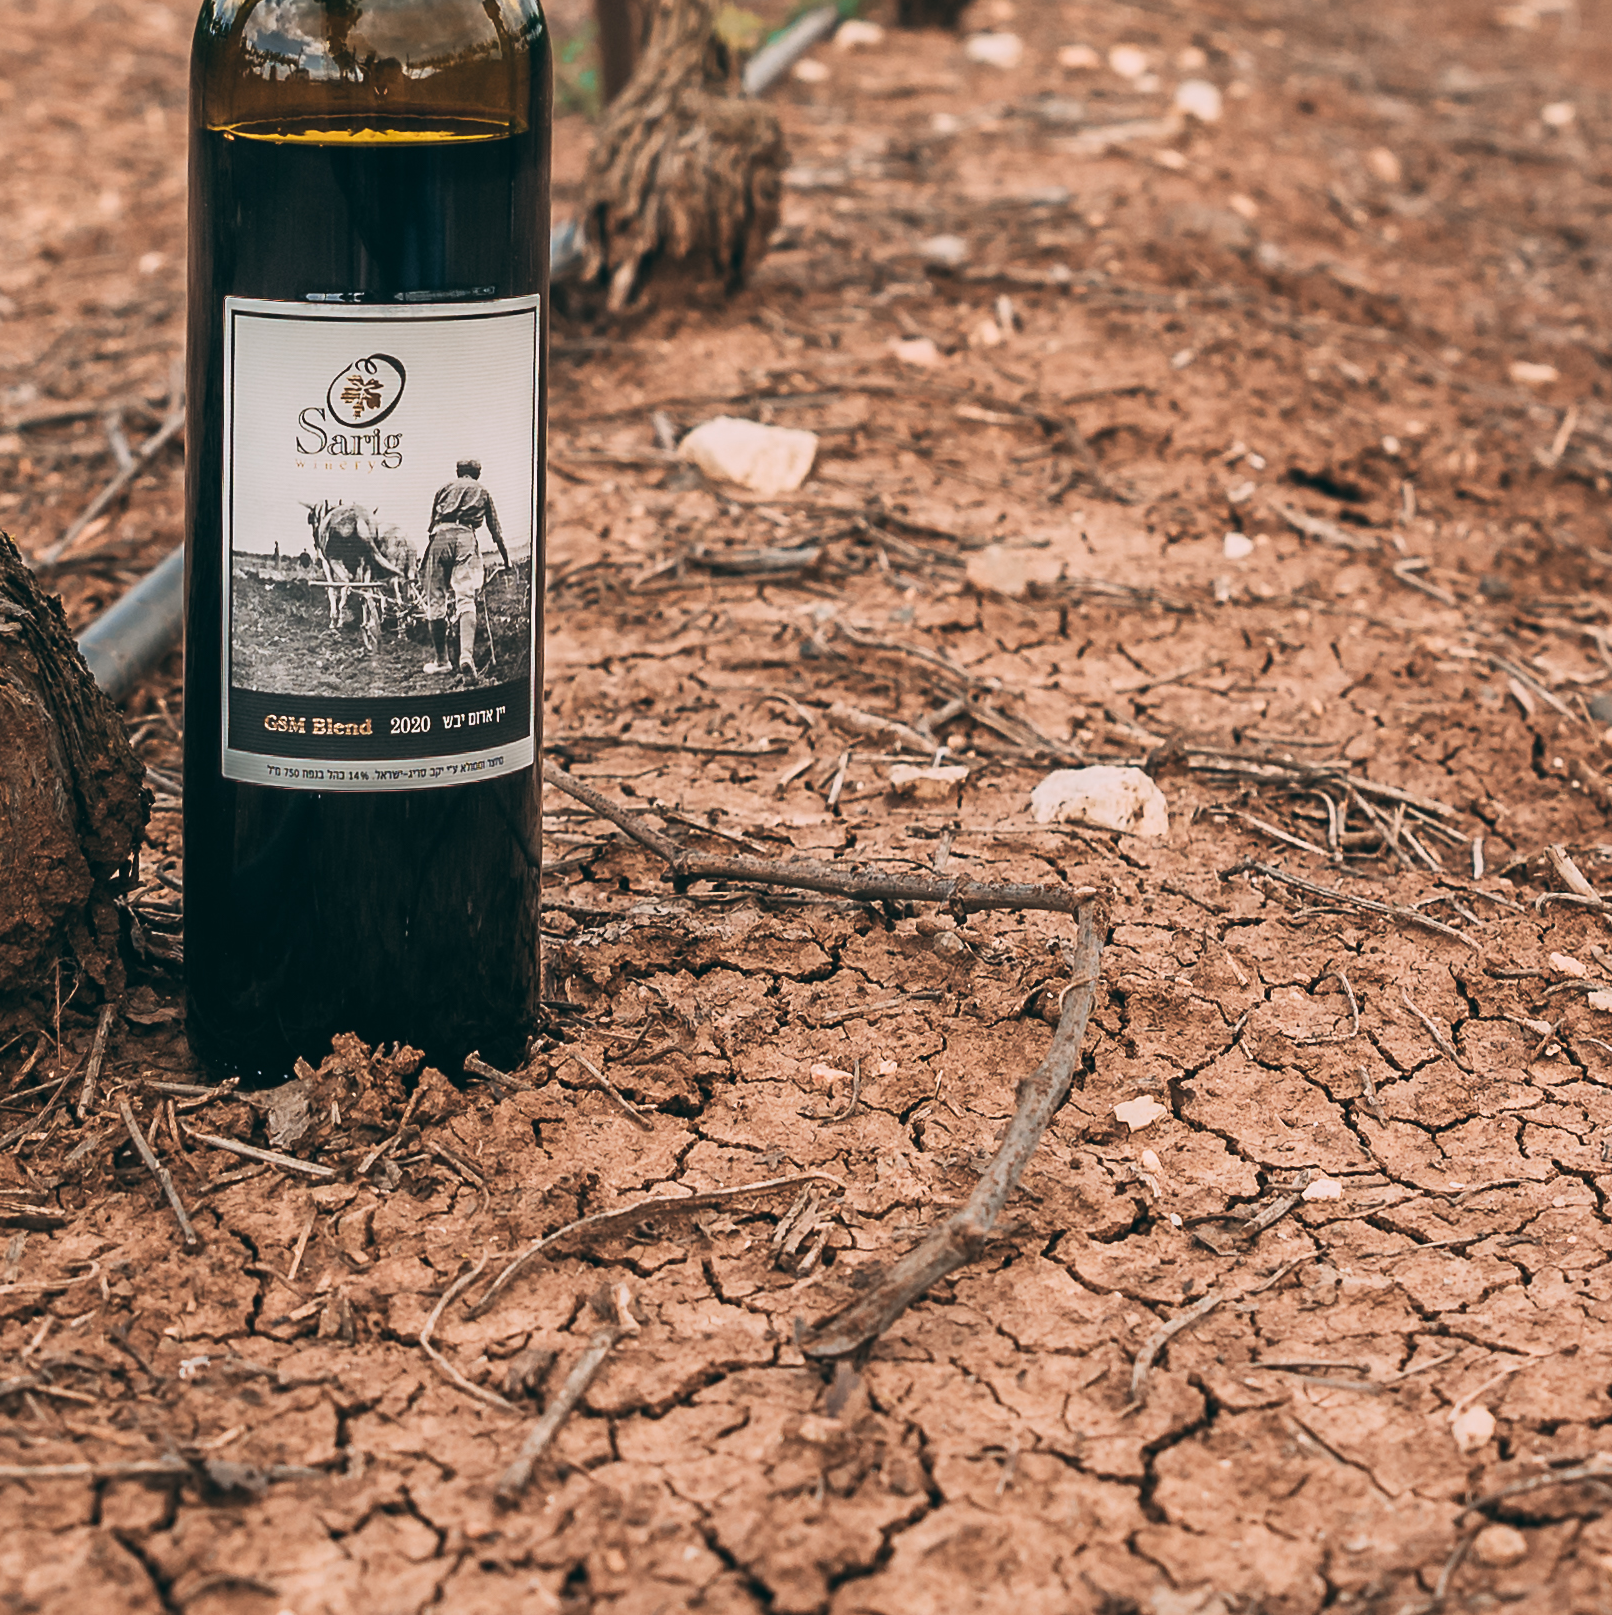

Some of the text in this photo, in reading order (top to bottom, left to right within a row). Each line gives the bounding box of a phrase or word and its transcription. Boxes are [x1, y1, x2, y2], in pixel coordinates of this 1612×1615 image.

[295, 407, 403, 469] Sarig
[442, 706, 506, 729] יין אדום יבש
[264, 714, 431, 735] GSM Blend 2020
[284, 767, 299, 778] 750
[302, 769, 324, 779] בנפח
[327, 769, 345, 780] כהל
[349, 771, 369, 781] 14%
[430, 766, 444, 778] יקב
